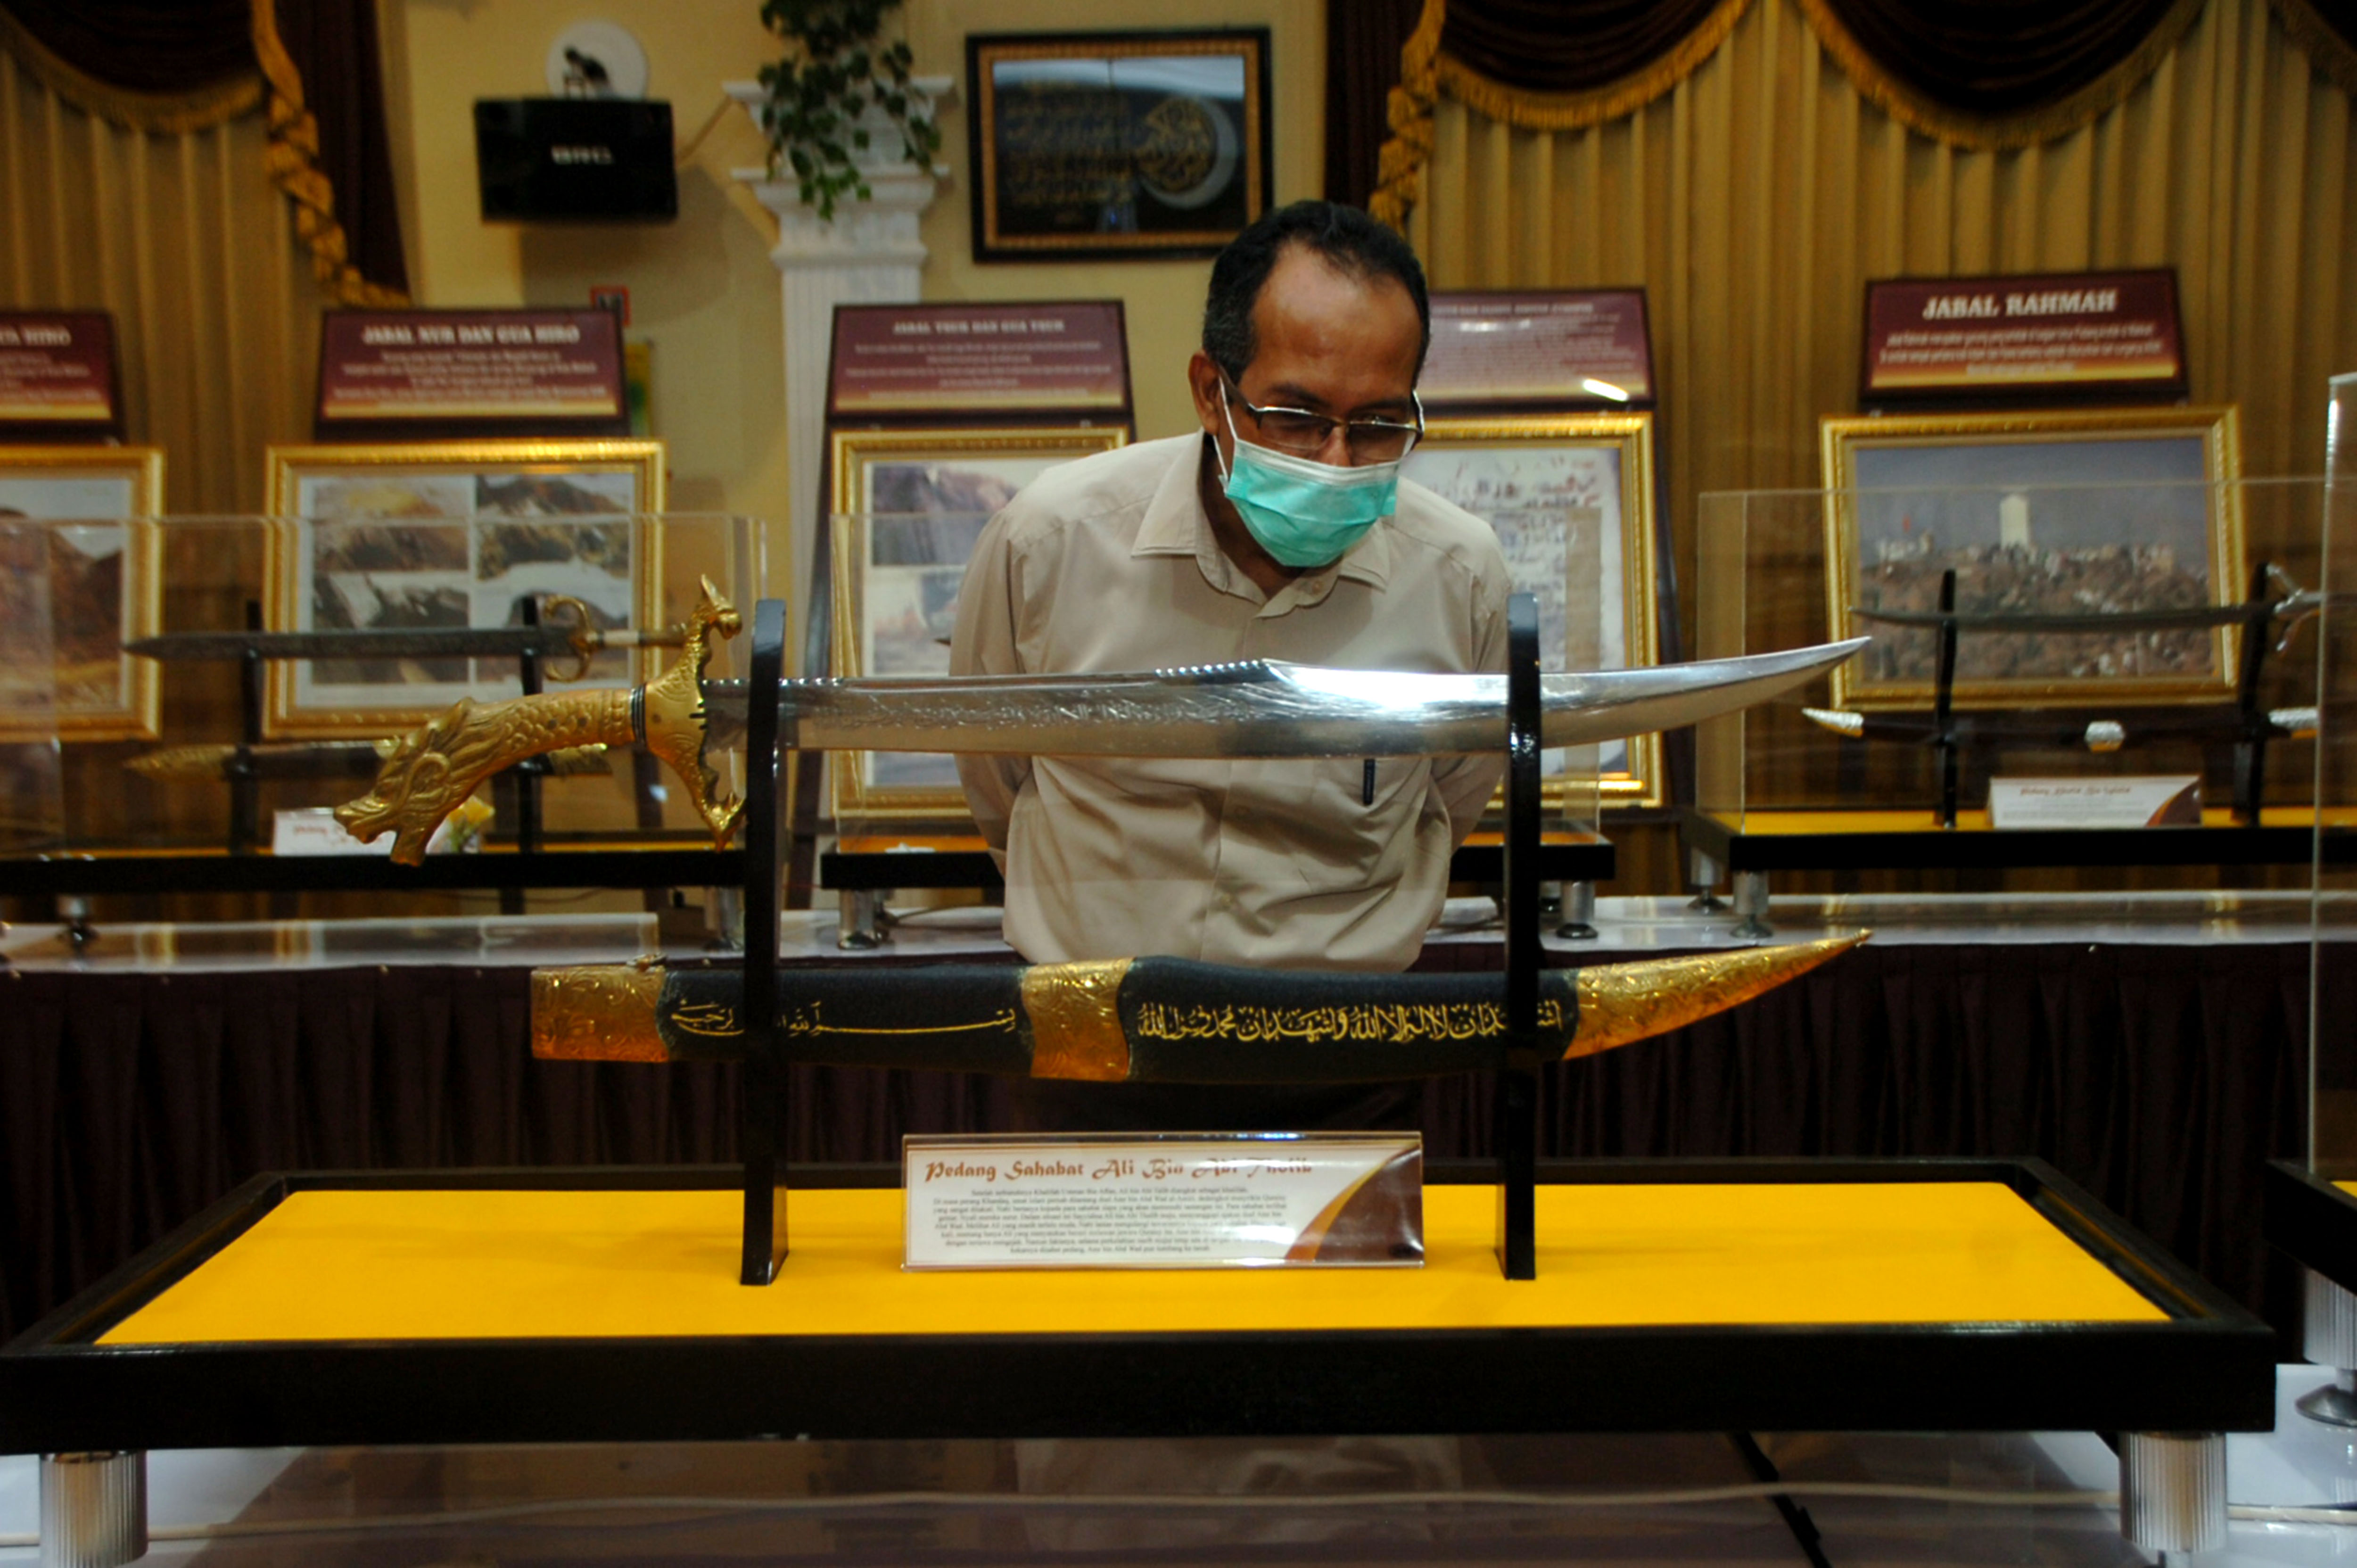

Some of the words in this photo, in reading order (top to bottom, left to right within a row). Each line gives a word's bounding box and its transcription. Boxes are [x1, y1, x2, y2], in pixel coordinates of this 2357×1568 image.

[1922, 294, 1999, 320] JABAL
[2004, 289, 2118, 316] RAHMAH
[925, 1161, 997, 1182] Pedang
[1004, 1160, 1084, 1180] Sahabat
[1092, 1159, 1134, 1180] Ali
[1142, 1158, 1183, 1179] Bin
